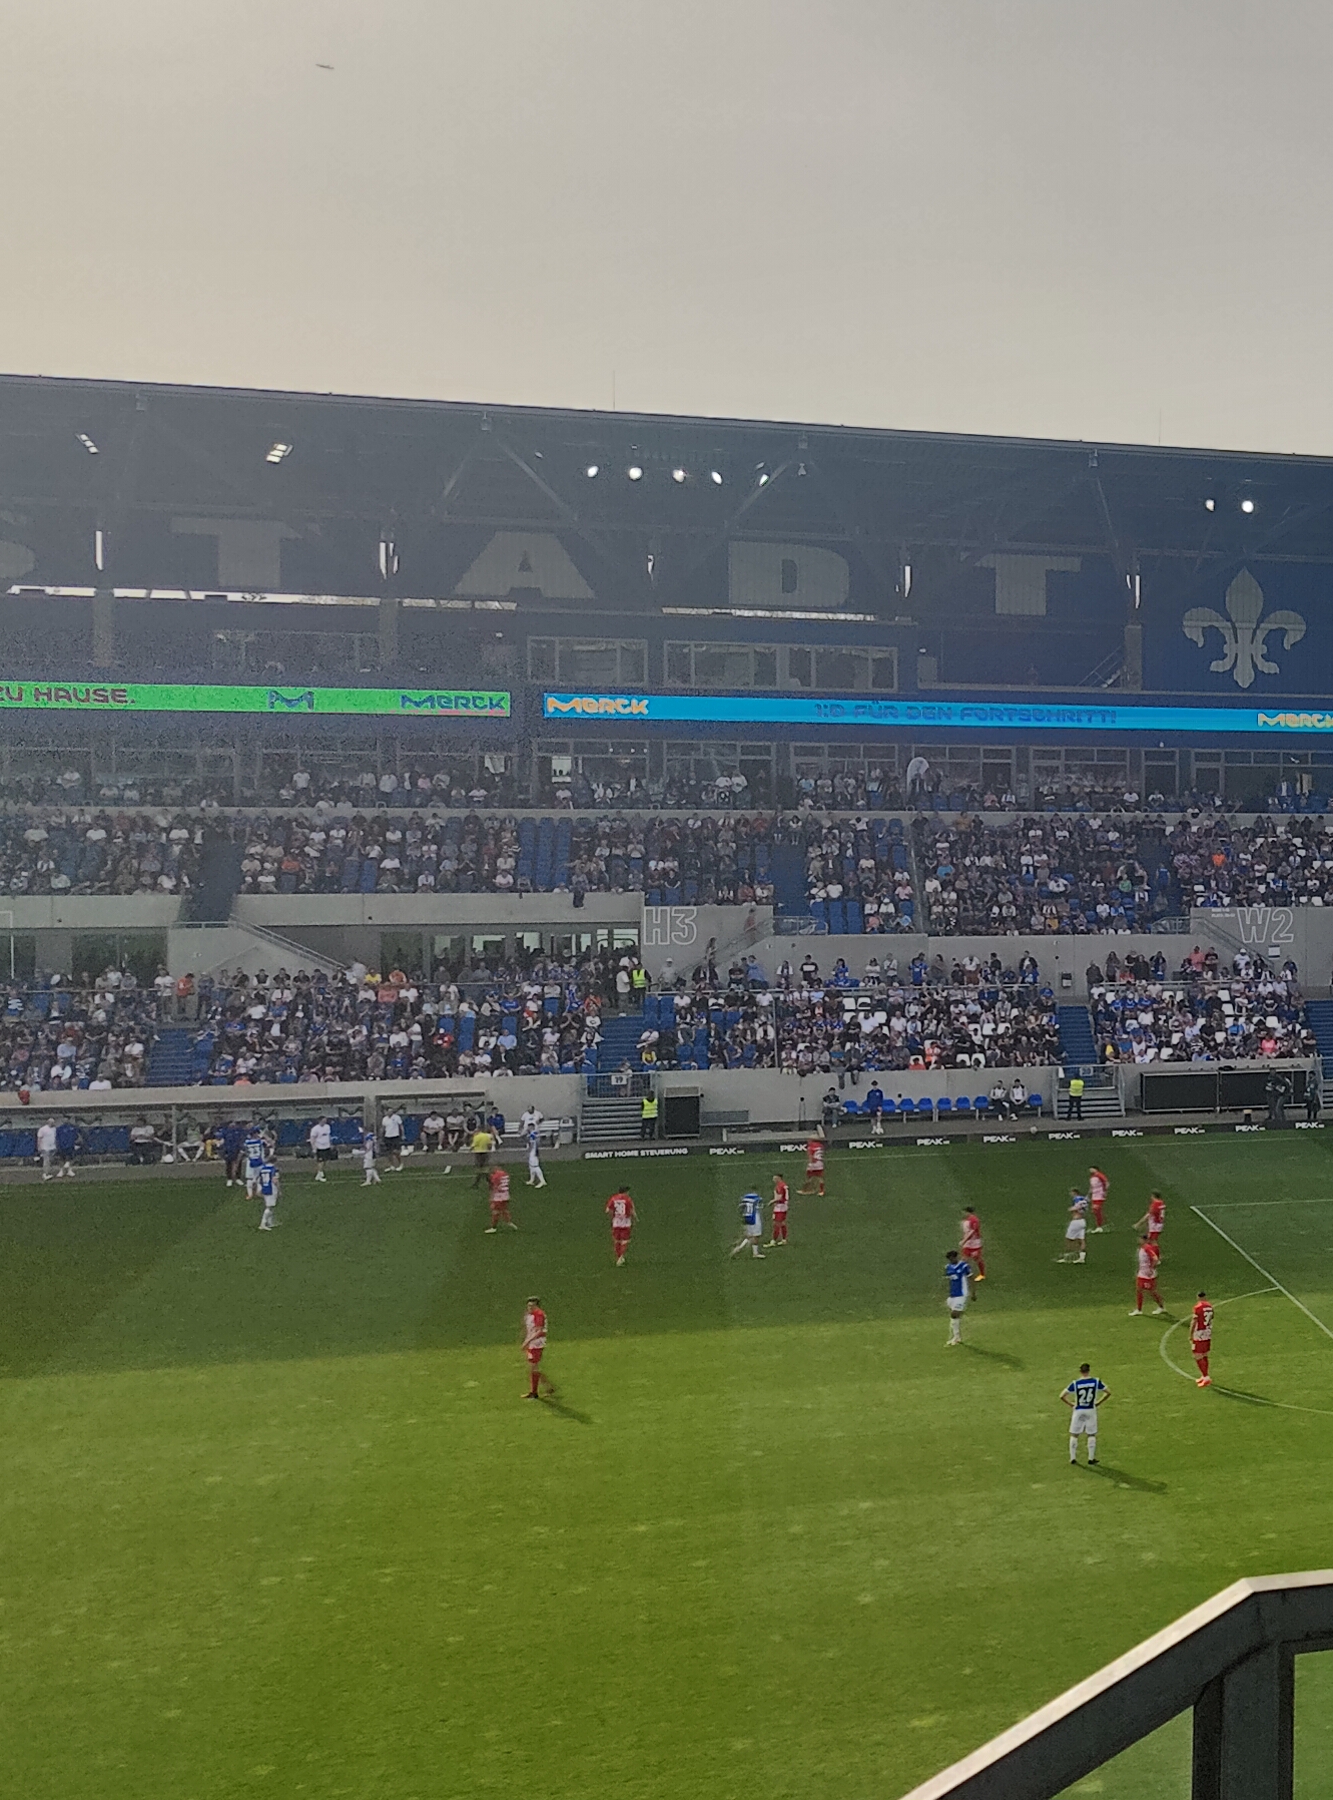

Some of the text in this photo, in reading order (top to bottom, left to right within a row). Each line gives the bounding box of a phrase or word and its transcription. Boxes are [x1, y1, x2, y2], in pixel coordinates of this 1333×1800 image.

[34, 687, 136, 704] HAUSE.
[854, 700, 899, 719] FÜR
[906, 706, 953, 721] DEN
[643, 906, 697, 945] H3
[1236, 907, 1294, 943] W2
[1174, 1127, 1199, 1135] PEAK
[1236, 1124, 1259, 1132] PEAK
[1112, 1129, 1137, 1137] PEAK
[983, 1135, 1008, 1143] PEAK
[780, 1144, 807, 1152] PEAK
[849, 1141, 875, 1149] PEAK
[584, 1148, 688, 1159] SMART HOME STEUERUNG
[709, 1147, 736, 1155] PEAK
[1078, 1388, 1094, 1403] 26
